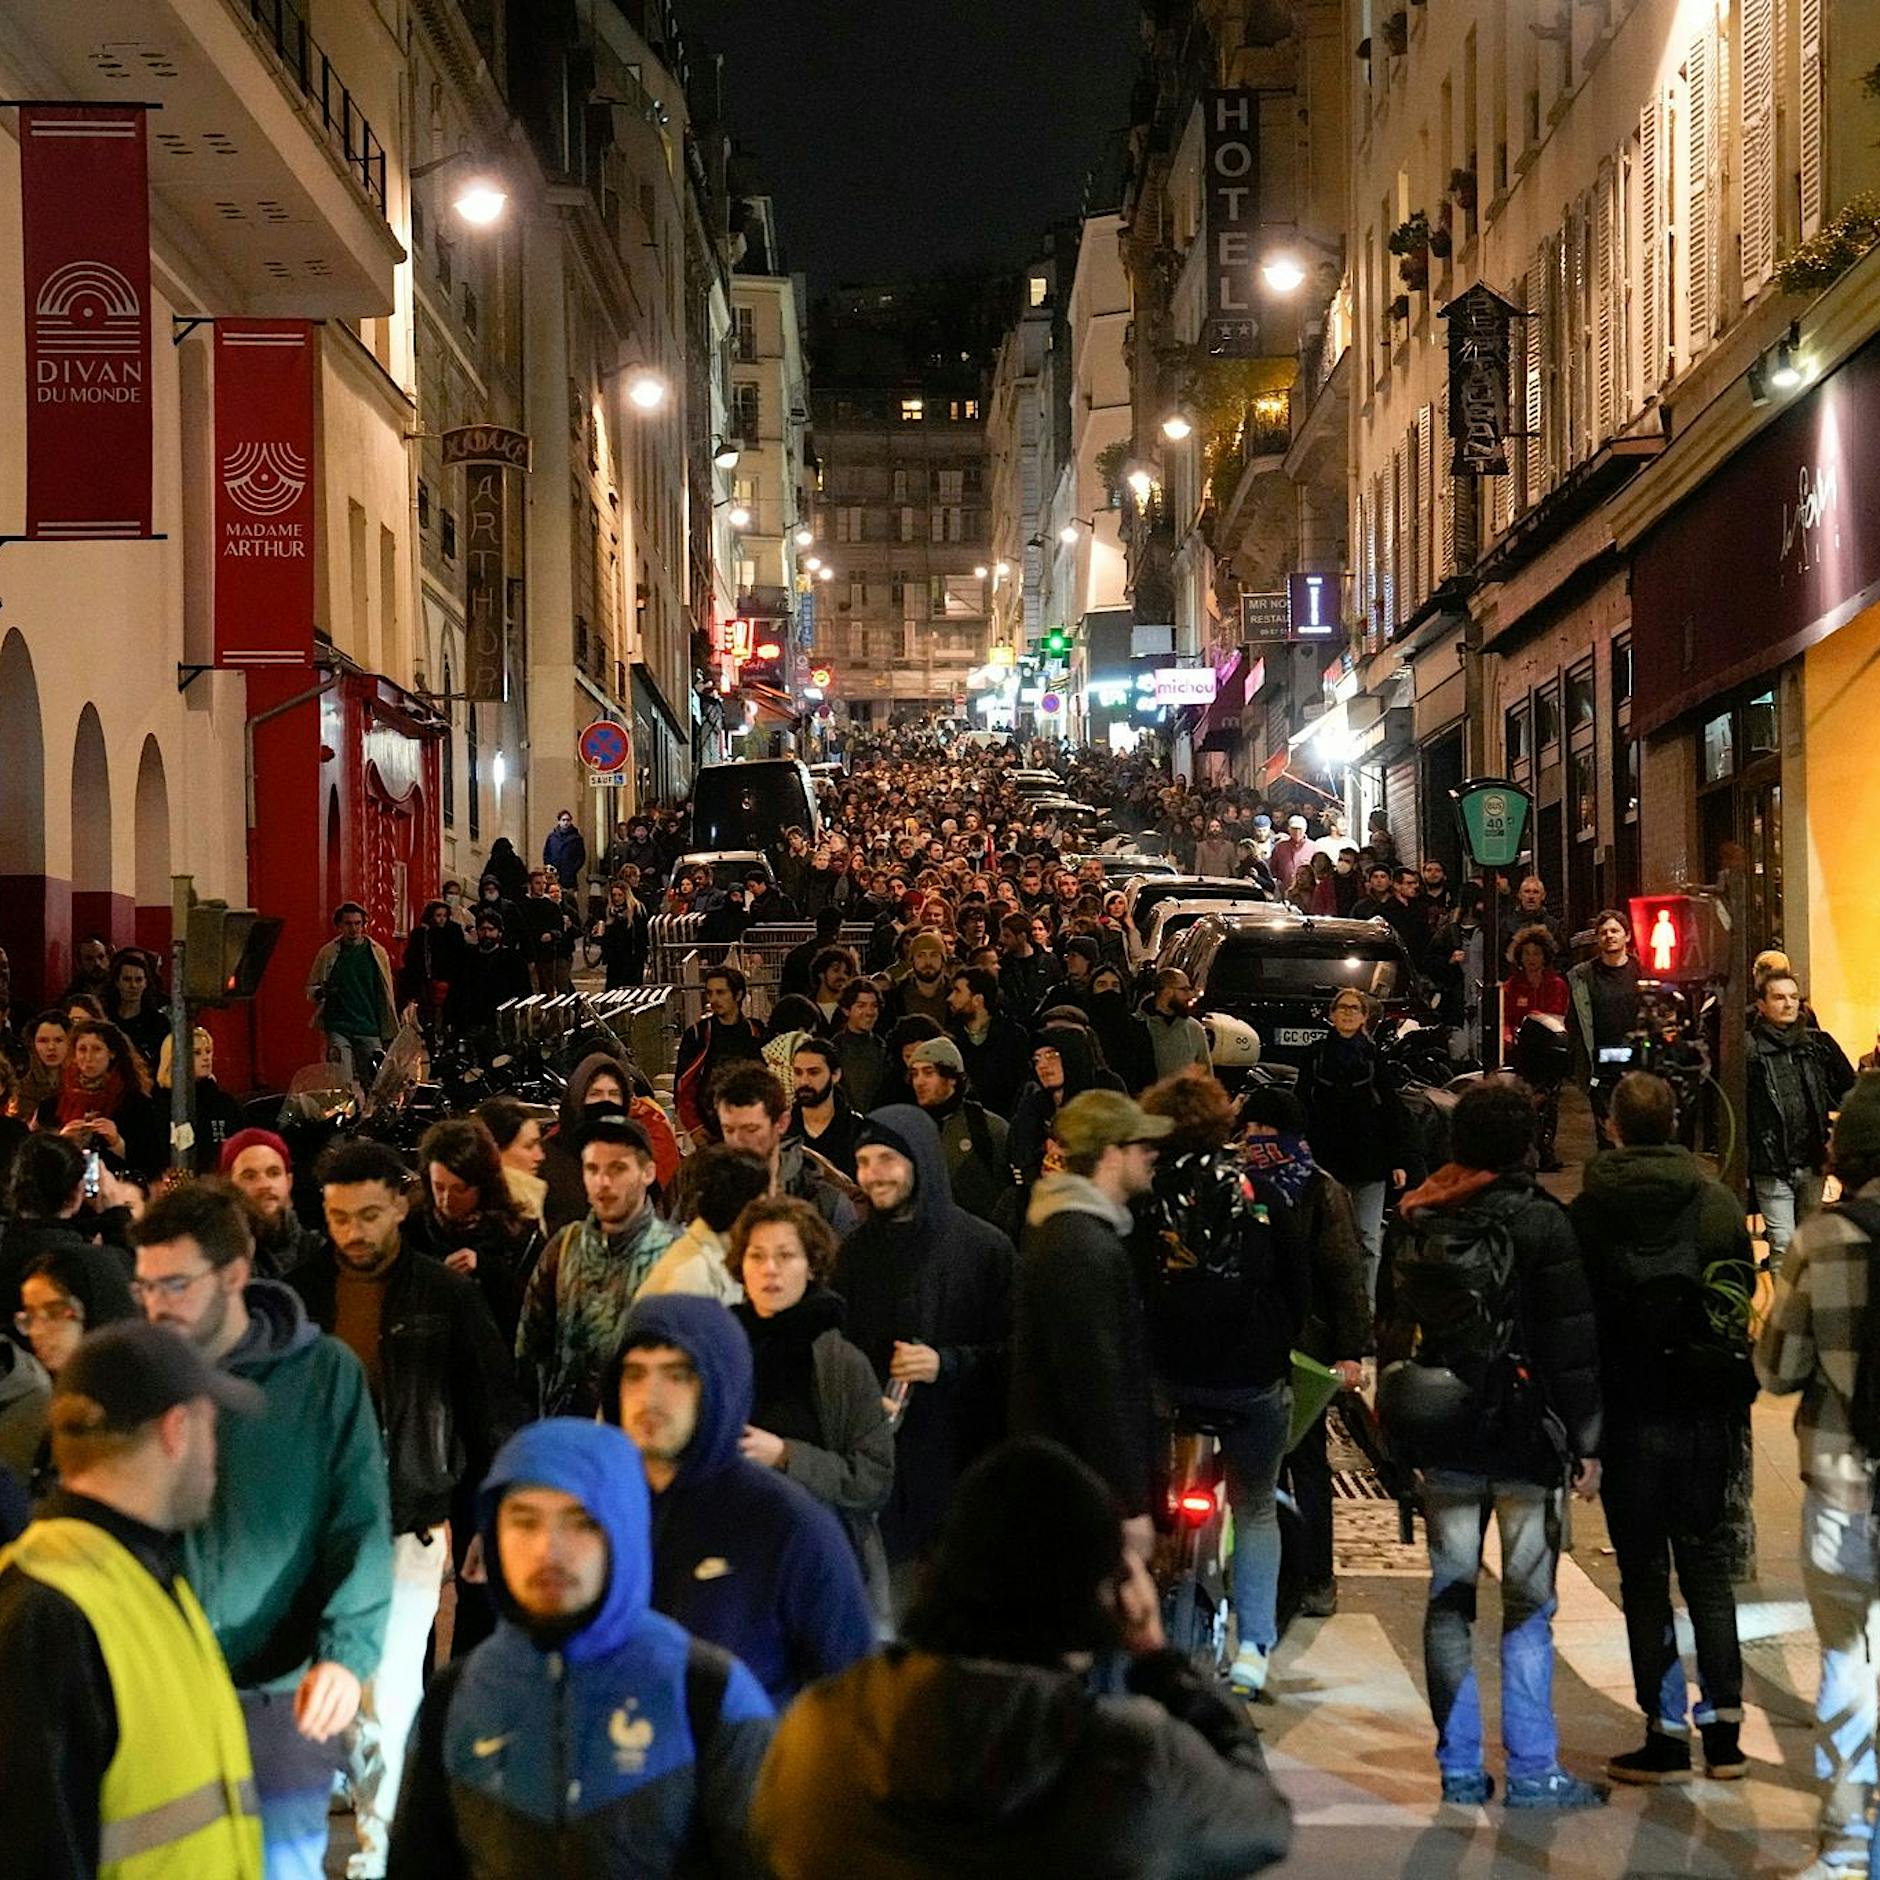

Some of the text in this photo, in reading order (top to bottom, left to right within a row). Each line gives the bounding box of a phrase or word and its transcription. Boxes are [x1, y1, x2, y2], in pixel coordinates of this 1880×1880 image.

[1214, 97, 1252, 310] HOTEL
[37, 360, 142, 383] DIVAN
[37, 387, 143, 403] DU MONDE
[226, 523, 304, 537] MADAME
[224, 540, 306, 557] ARTHUR
[470, 474, 499, 695] ARTHUR
[1249, 599, 1267, 609] MR
[591, 776, 612, 785] SAUF
[1487, 818, 1503, 828] 40
